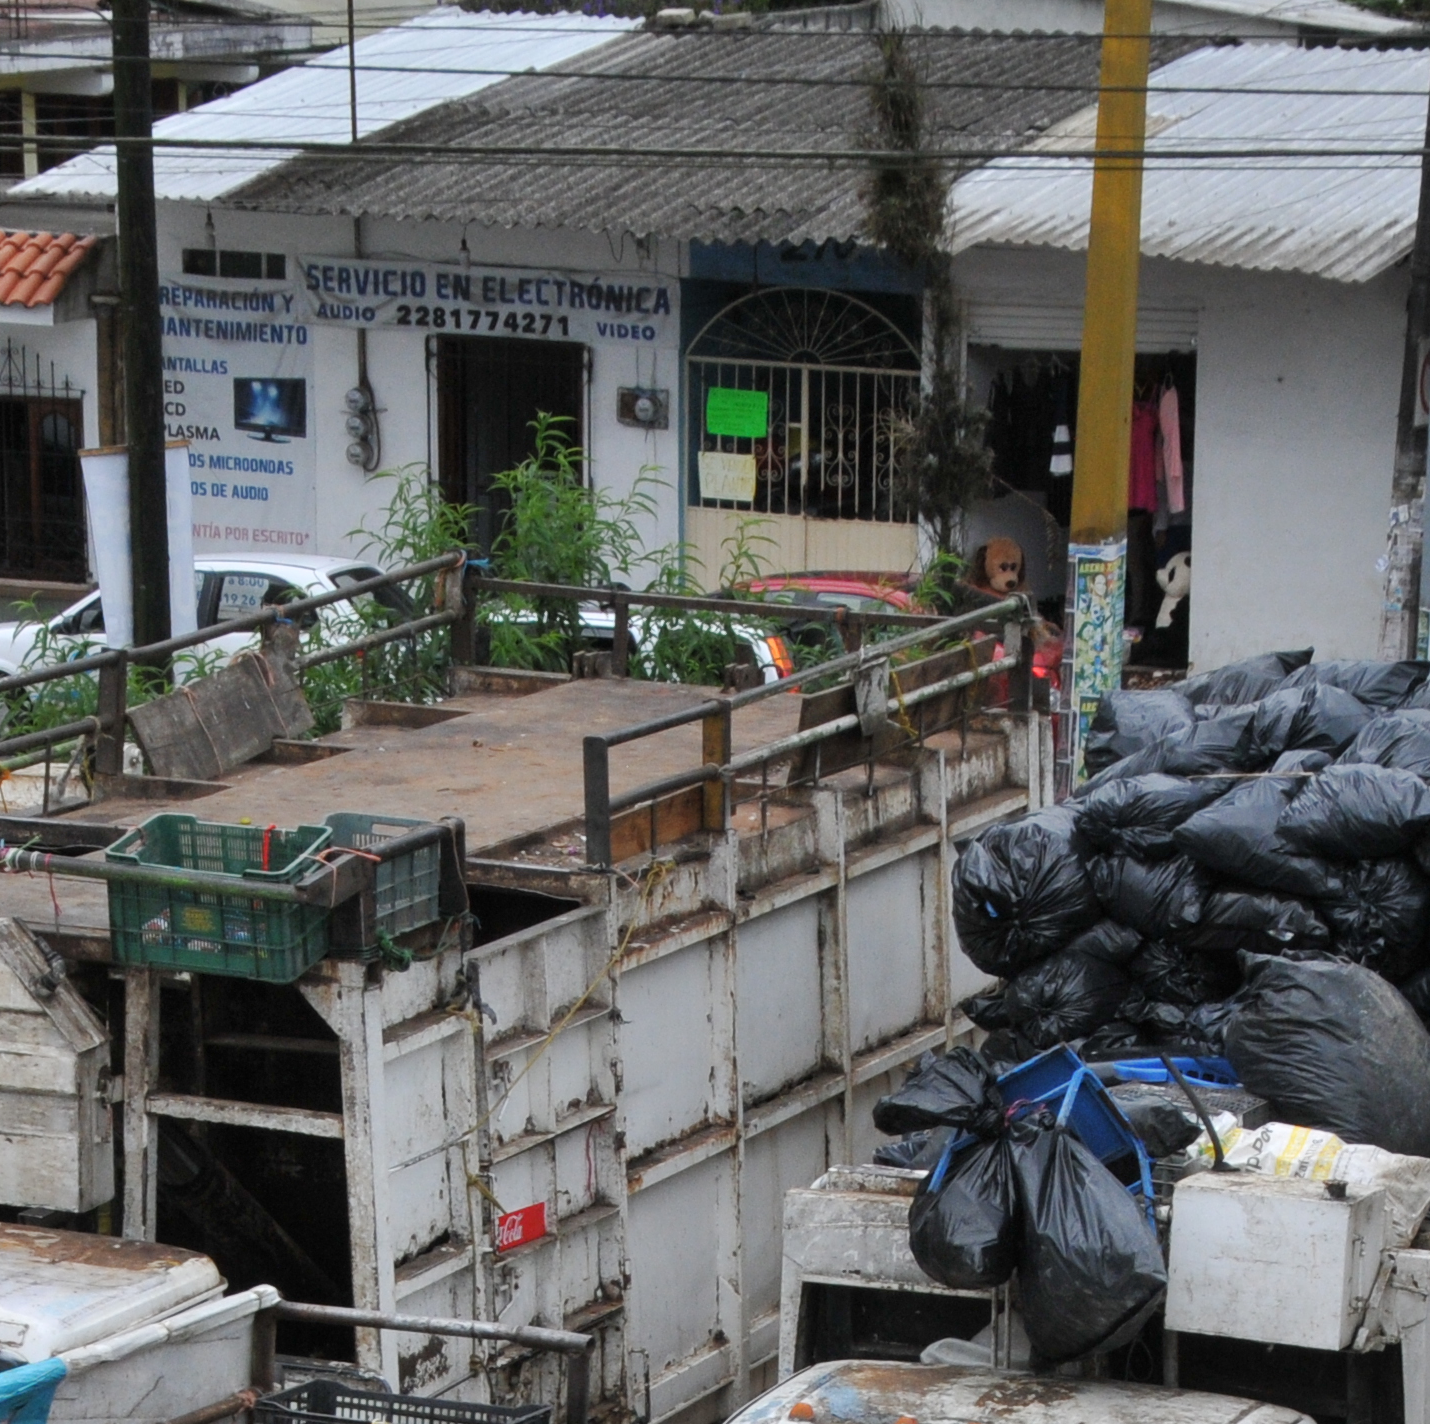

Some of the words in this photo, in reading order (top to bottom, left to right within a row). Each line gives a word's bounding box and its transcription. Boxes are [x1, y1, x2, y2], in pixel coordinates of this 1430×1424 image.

[306, 264, 426, 298] SERVICIO
[436, 273, 470, 301] EN
[482, 276, 671, 315] ELECTRÓNICA
[159, 286, 275, 313] REPARACIÓN
[281, 294, 294, 313] Y
[317, 303, 376, 322] AUDIO
[396, 304, 569, 336] 2281774271
[597, 321, 656, 341] VIDEO
[162, 356, 228, 375] ANTALLAS
[164, 380, 185, 395] ED
[164, 402, 186, 416] CD
[209, 454, 294, 475] MICROONDAS
[211, 482, 227, 498] DE
[231, 485, 269, 501] AUDIO
[225, 526, 249, 541] POR
